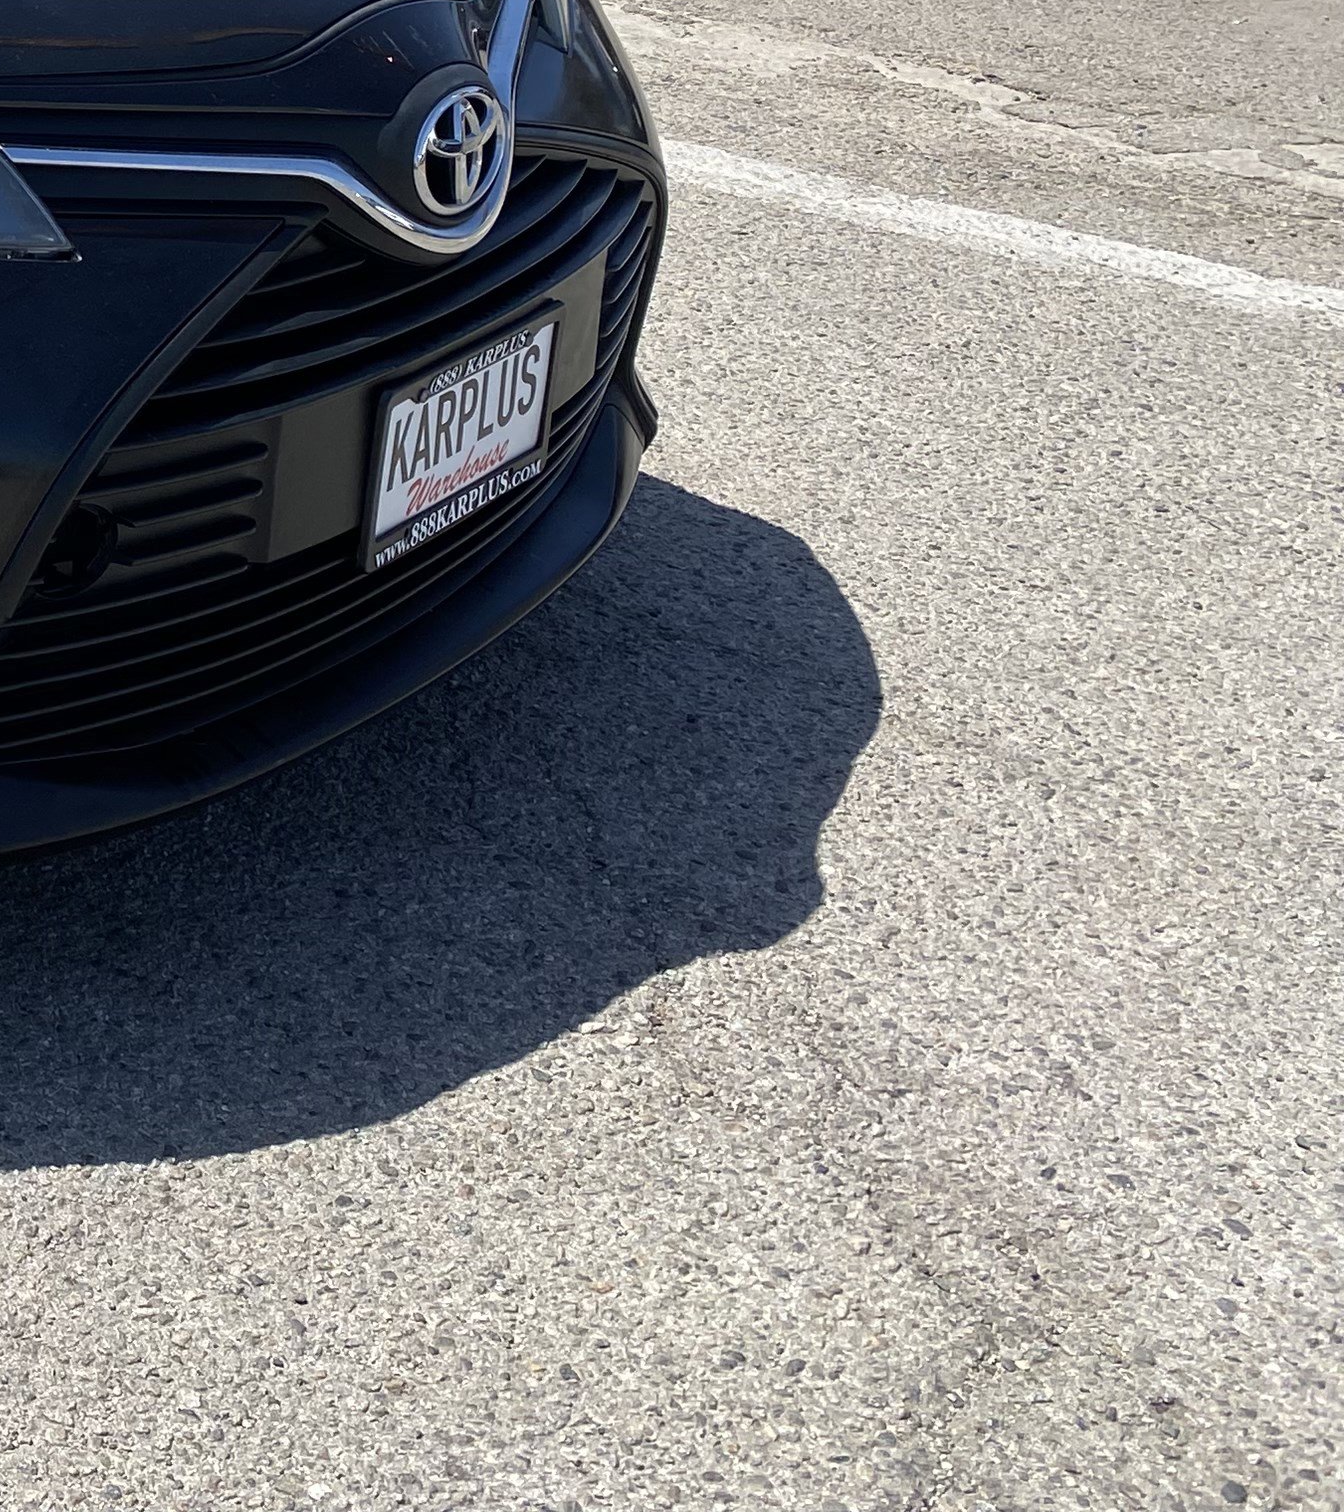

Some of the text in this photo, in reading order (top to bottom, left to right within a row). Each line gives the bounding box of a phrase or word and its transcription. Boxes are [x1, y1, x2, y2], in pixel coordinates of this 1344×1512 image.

[430, 330, 530, 393] (888) KARPLUS
[386, 344, 540, 492] KARPLUS
[405, 438, 510, 516] Warehouse
